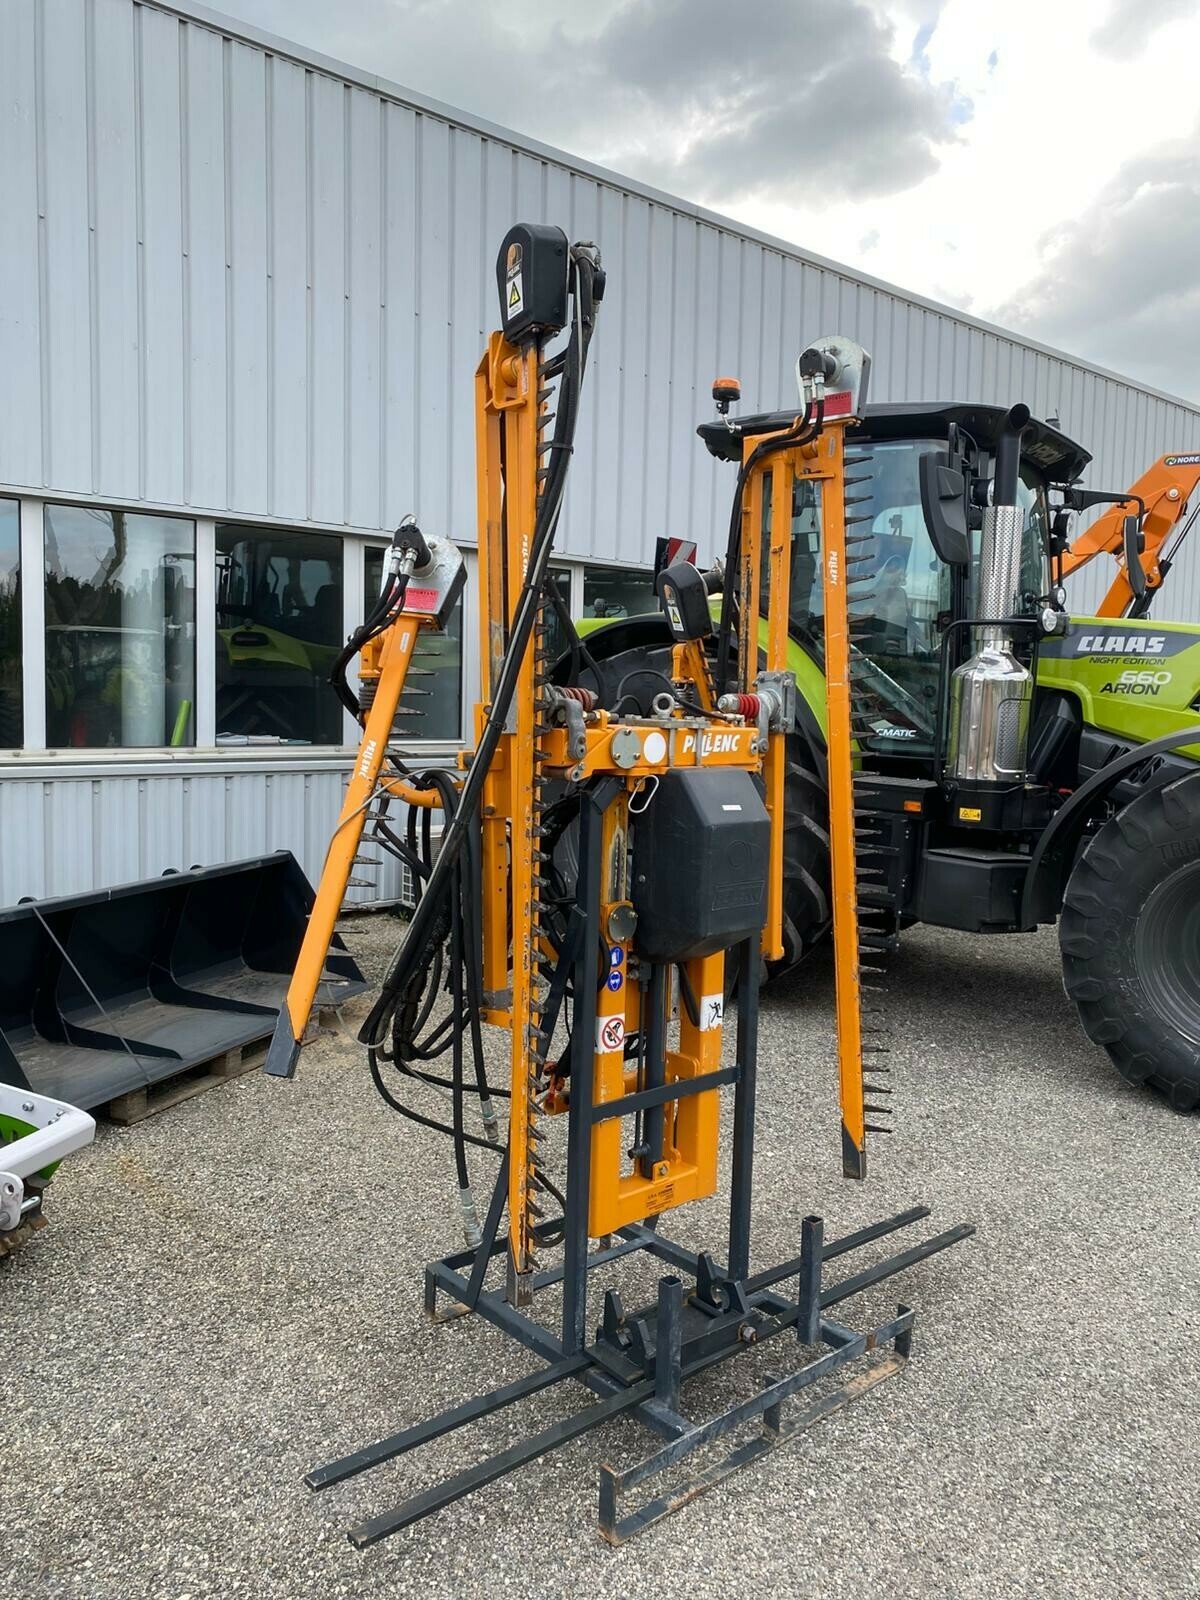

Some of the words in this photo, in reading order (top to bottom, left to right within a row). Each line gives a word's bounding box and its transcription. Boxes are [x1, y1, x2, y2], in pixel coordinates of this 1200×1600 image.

[1077, 636, 1166, 653] CLAAS
[1089, 656, 1121, 665] NIGHT
[1122, 657, 1166, 666] EDITION
[1119, 670, 1173, 685] 660
[1100, 683, 1161, 696] ARION
[876, 728, 918, 738] CMATIC
[358, 739, 377, 778] PELLENC
